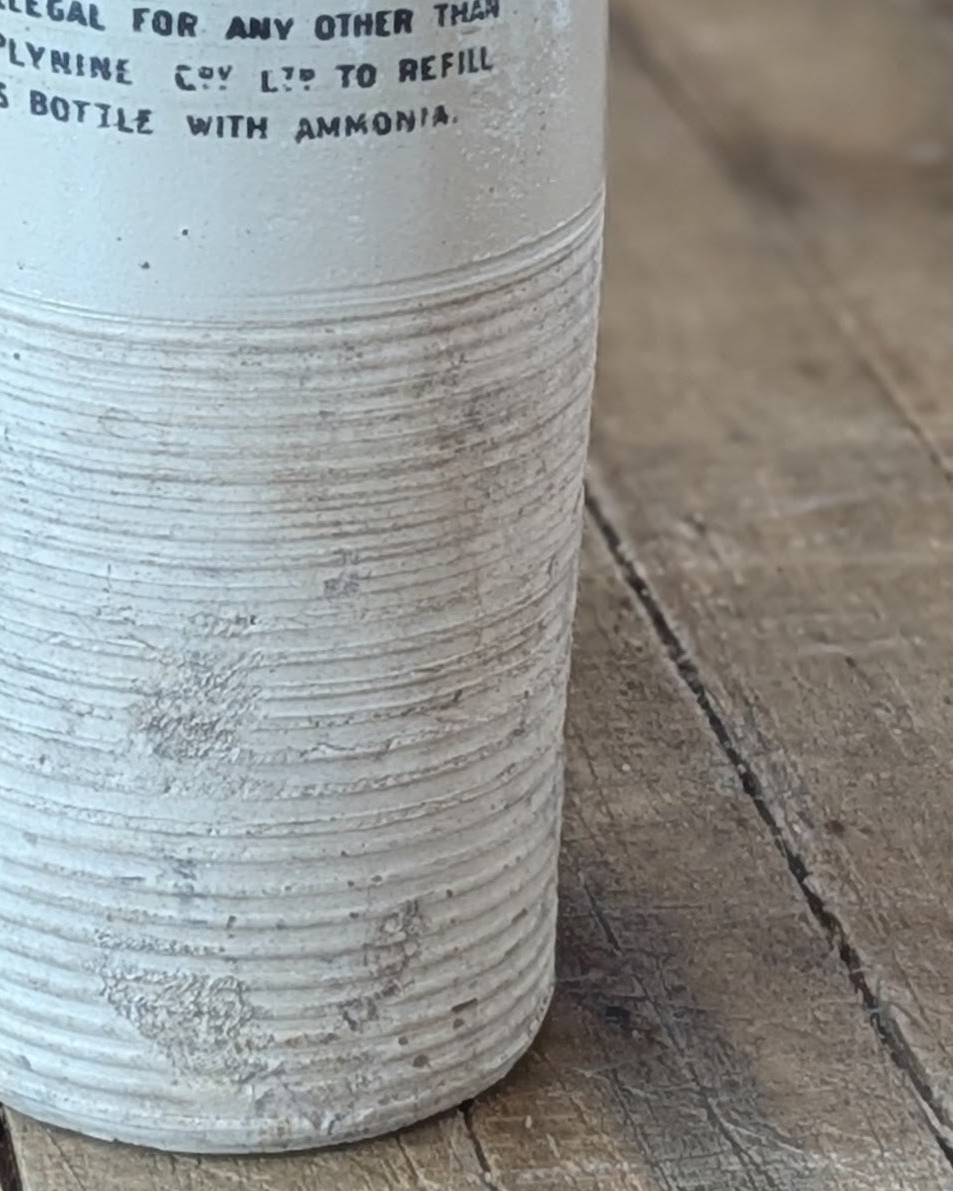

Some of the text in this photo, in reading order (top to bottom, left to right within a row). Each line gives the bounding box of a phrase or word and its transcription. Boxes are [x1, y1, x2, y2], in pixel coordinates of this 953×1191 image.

[132, 8, 198, 38] FOR
[225, 16, 294, 40] ANY
[315, 9, 414, 41] OTHER
[336, 62, 378, 89] TO
[398, 46, 495, 83] REFILL
[29, 89, 154, 135] BOTTLE
[186, 115, 269, 140] WITH
[295, 105, 459, 145] AMMONIA.
